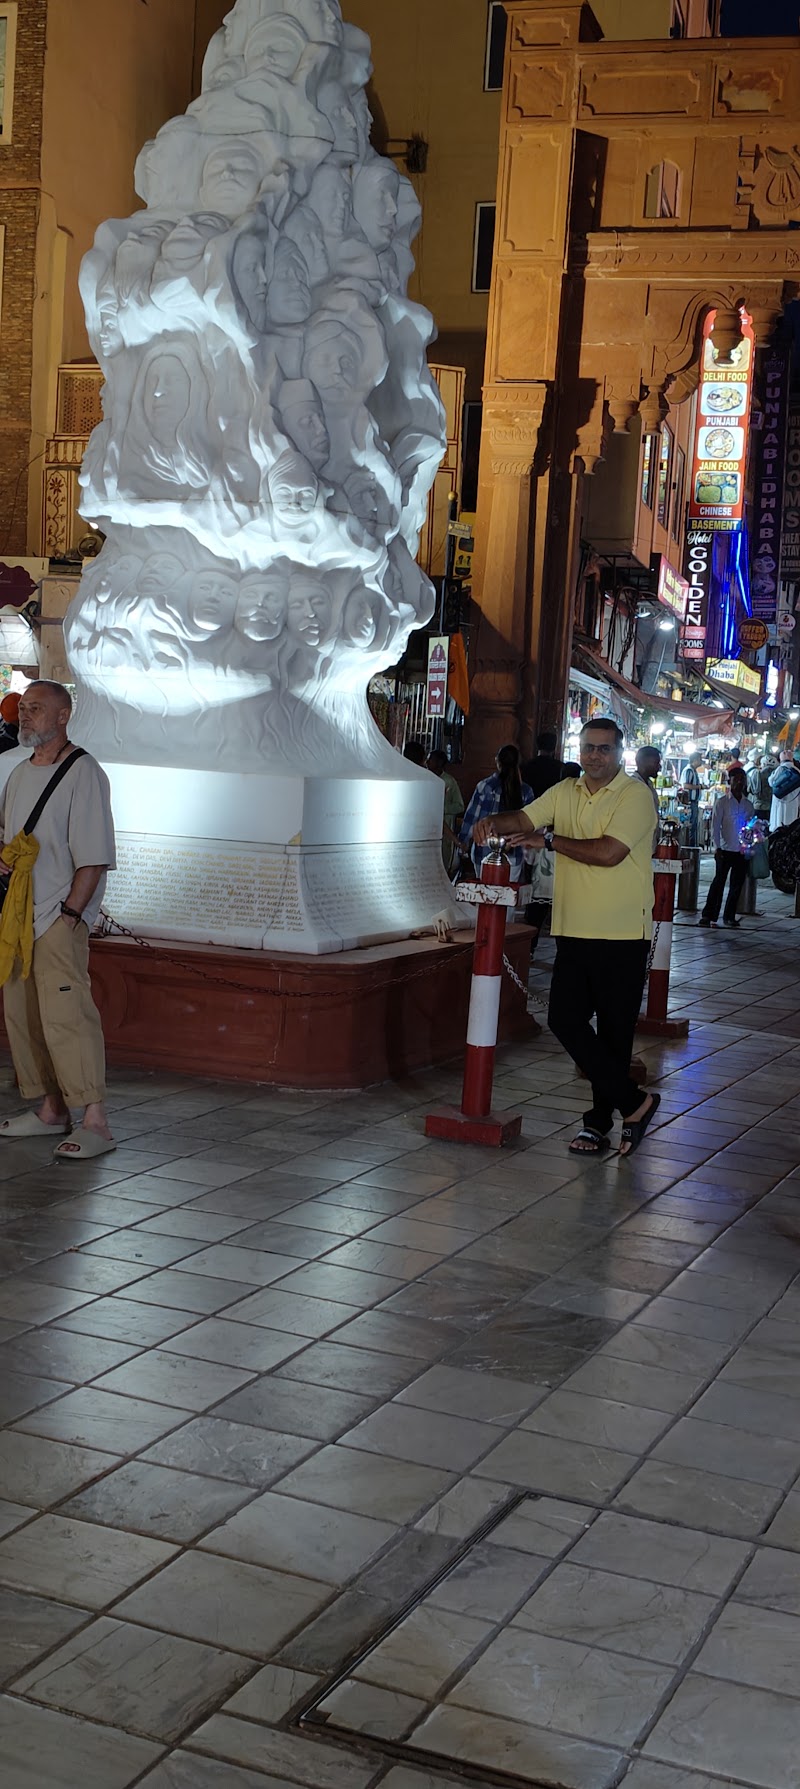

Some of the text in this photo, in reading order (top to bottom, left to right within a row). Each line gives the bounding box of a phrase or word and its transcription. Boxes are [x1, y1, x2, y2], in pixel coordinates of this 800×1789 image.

[703, 372, 748, 382] DELHI FOOD
[706, 417, 739, 427] PUNJABI
[763, 372, 782, 475] PUNJABI
[699, 461, 739, 471] JAIN FOOD
[699, 507, 732, 516] CHINESE
[758, 482, 777, 554] DHABA
[691, 519, 739, 531] BASEMENT
[687, 531, 713, 546] Hotel
[685, 547, 709, 627] GOLDEN
[708, 669, 735, 679] Dhaba
